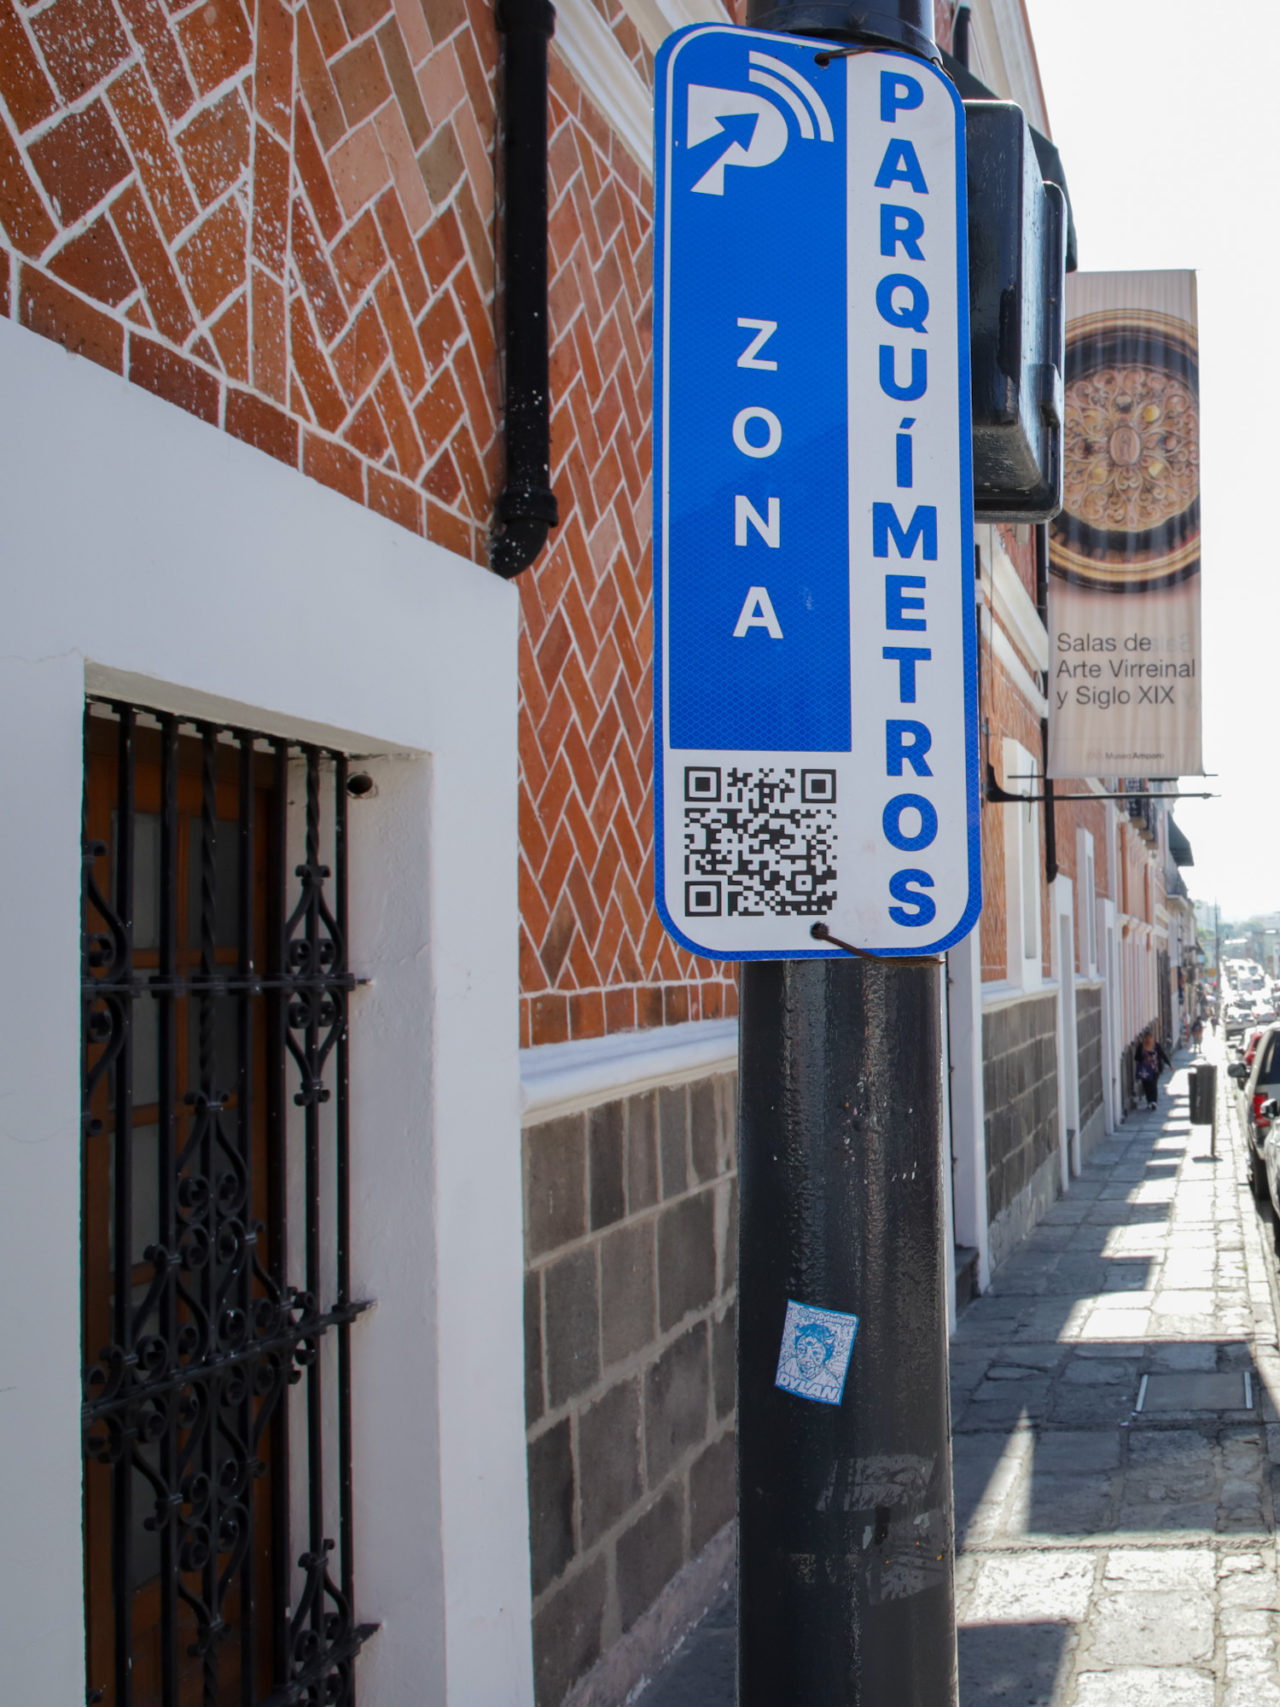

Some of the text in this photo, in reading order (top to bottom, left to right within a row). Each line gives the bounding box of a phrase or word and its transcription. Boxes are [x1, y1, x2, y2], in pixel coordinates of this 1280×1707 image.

[732, 316, 785, 640] ZONA
[872, 70, 939, 928] PARQUÍMETROS
[1056, 632, 1152, 652] Salas de
[1056, 658, 1196, 679] Arte Virreinal
[1056, 685, 1175, 710] y Siglo XIX
[779, 1372, 840, 1401] DYLAN
